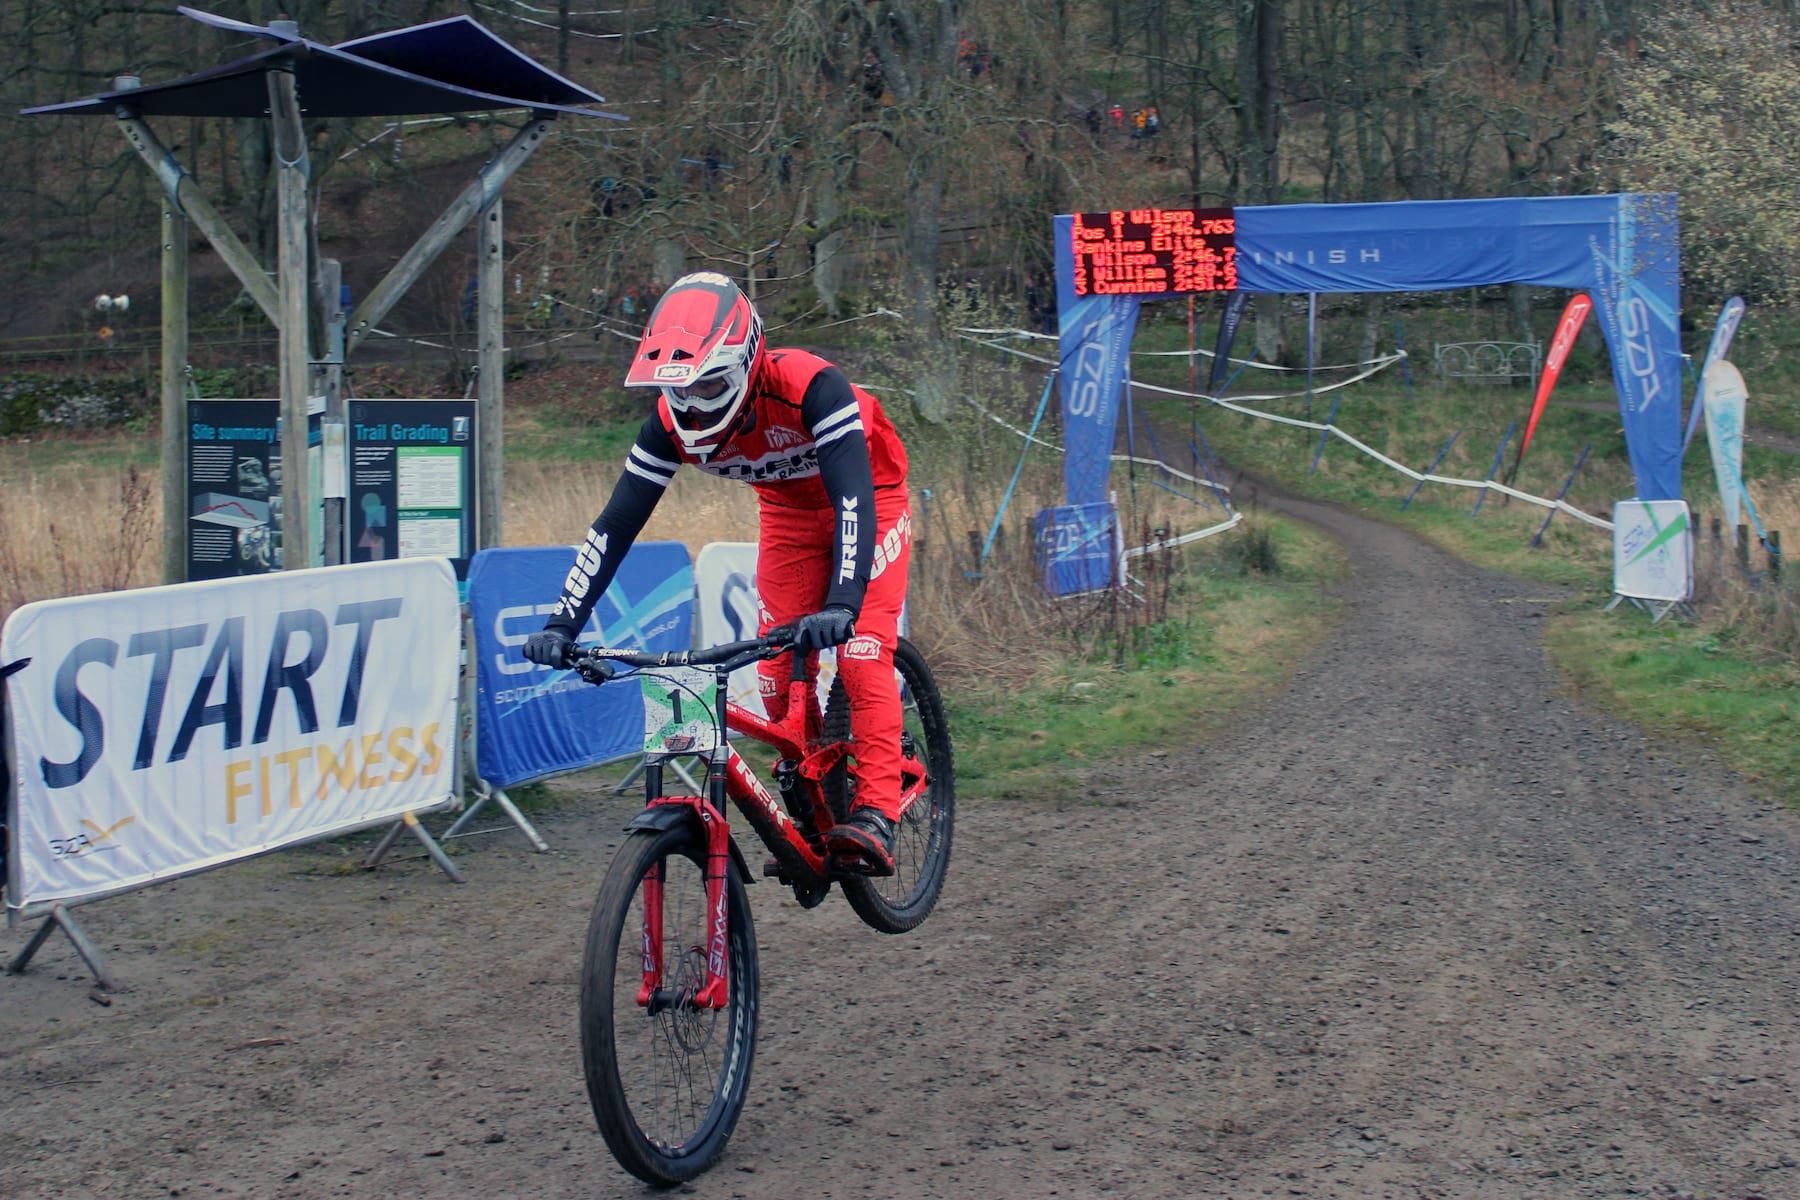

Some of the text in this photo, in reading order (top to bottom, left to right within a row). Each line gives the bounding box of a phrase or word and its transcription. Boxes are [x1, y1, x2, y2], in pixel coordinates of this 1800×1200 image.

[1110, 210, 1126, 225] R
[1130, 208, 1195, 225] Wilson
[1071, 219, 1236, 240] Pos 1 2:46.763
[1151, 235, 1207, 252] Elite
[1092, 251, 1158, 267] Wilson
[1172, 247, 1237, 264] 2:46.7
[1092, 265, 1167, 281] William
[1173, 262, 1238, 278] 2:48.6
[1173, 275, 1239, 292] 2:51.2
[659, 366, 689, 378] 100%
[192, 423, 276, 444] Site summary
[354, 424, 449, 444] Trail Grading
[779, 461, 819, 480] RACIN
[839, 495, 859, 585] TREK
[870, 509, 911, 580] 00%
[554, 527, 609, 619] 100%
[848, 641, 878, 655] 100%
[40, 597, 403, 789] START
[667, 689, 684, 724] 1
[225, 721, 443, 825] FITNESS
[728, 742, 788, 827] TREK
